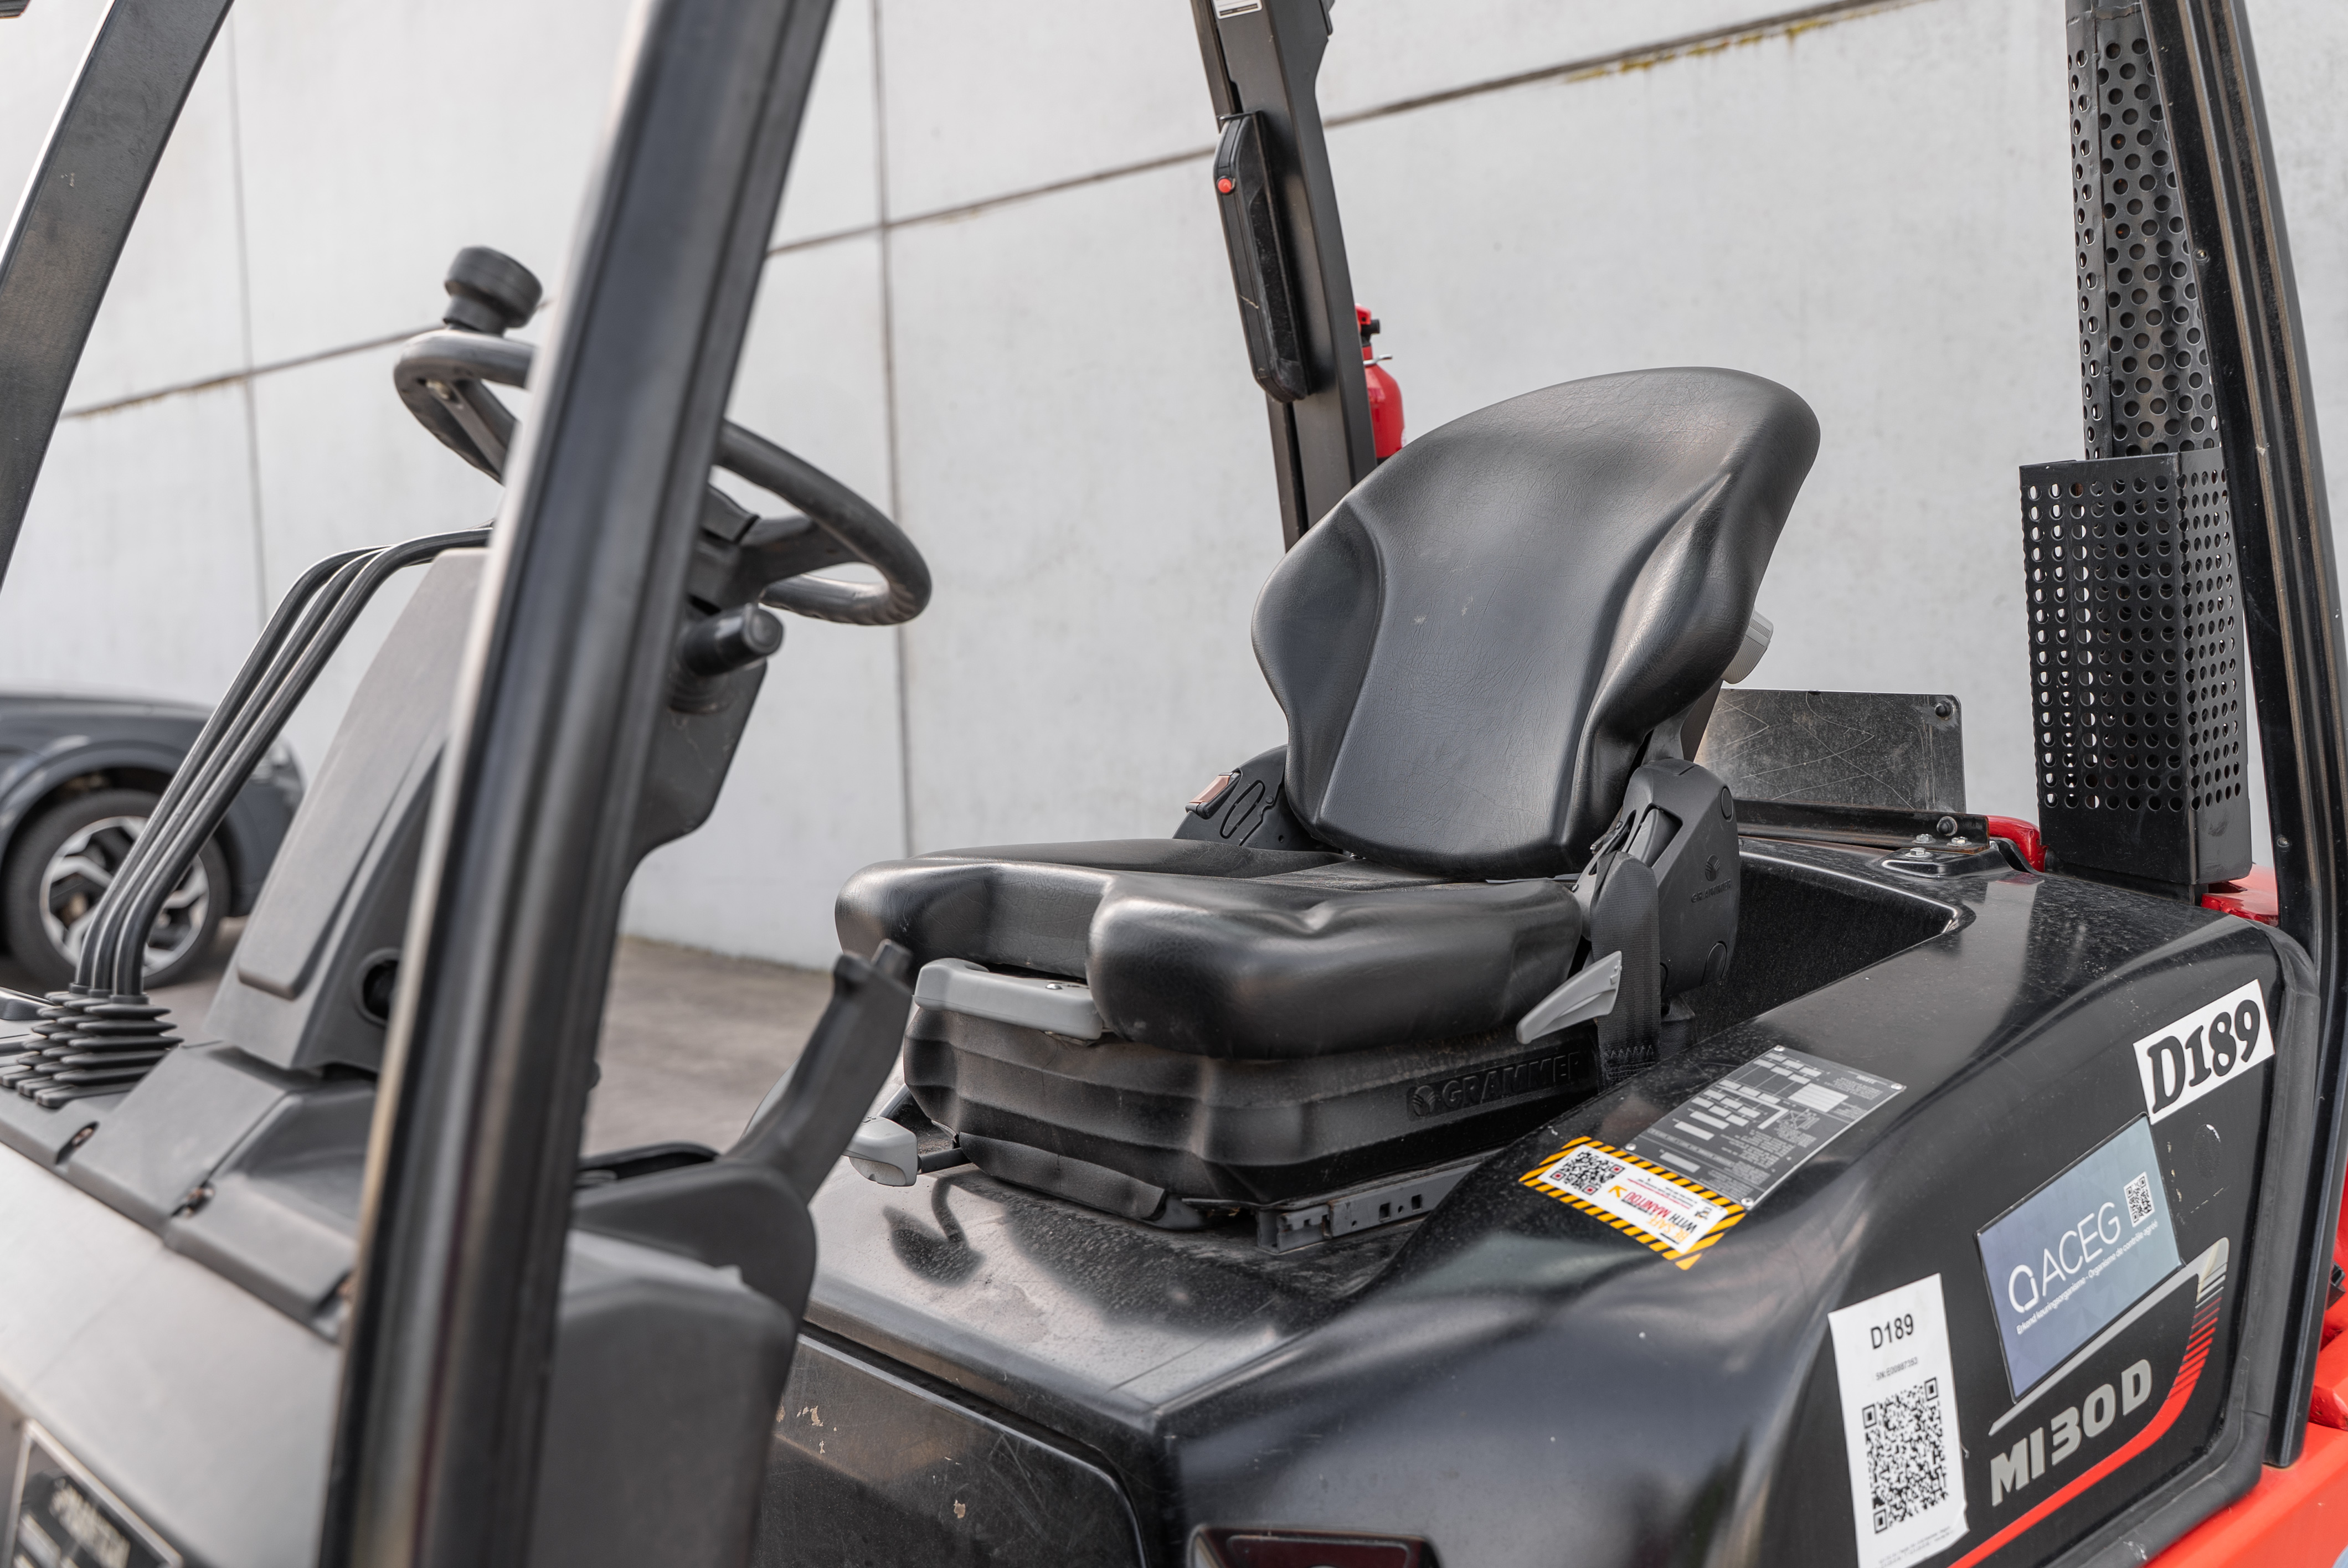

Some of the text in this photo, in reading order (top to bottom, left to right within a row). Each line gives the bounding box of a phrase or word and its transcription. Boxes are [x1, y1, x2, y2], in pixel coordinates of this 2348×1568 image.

[1691, 879, 1732, 902] GRAMMER
[1441, 1051, 1585, 1108] GRAMMER
[2147, 999, 2261, 1114] D189
[1624, 1191, 1672, 1218] MANITOU
[2016, 1312, 2038, 1335] Erkend
[2088, 1253, 2117, 1278] Organisme
[2115, 1247, 2123, 1257] de
[2122, 1231, 2144, 1251] contrôle
[1870, 1313, 1913, 1350] D189
